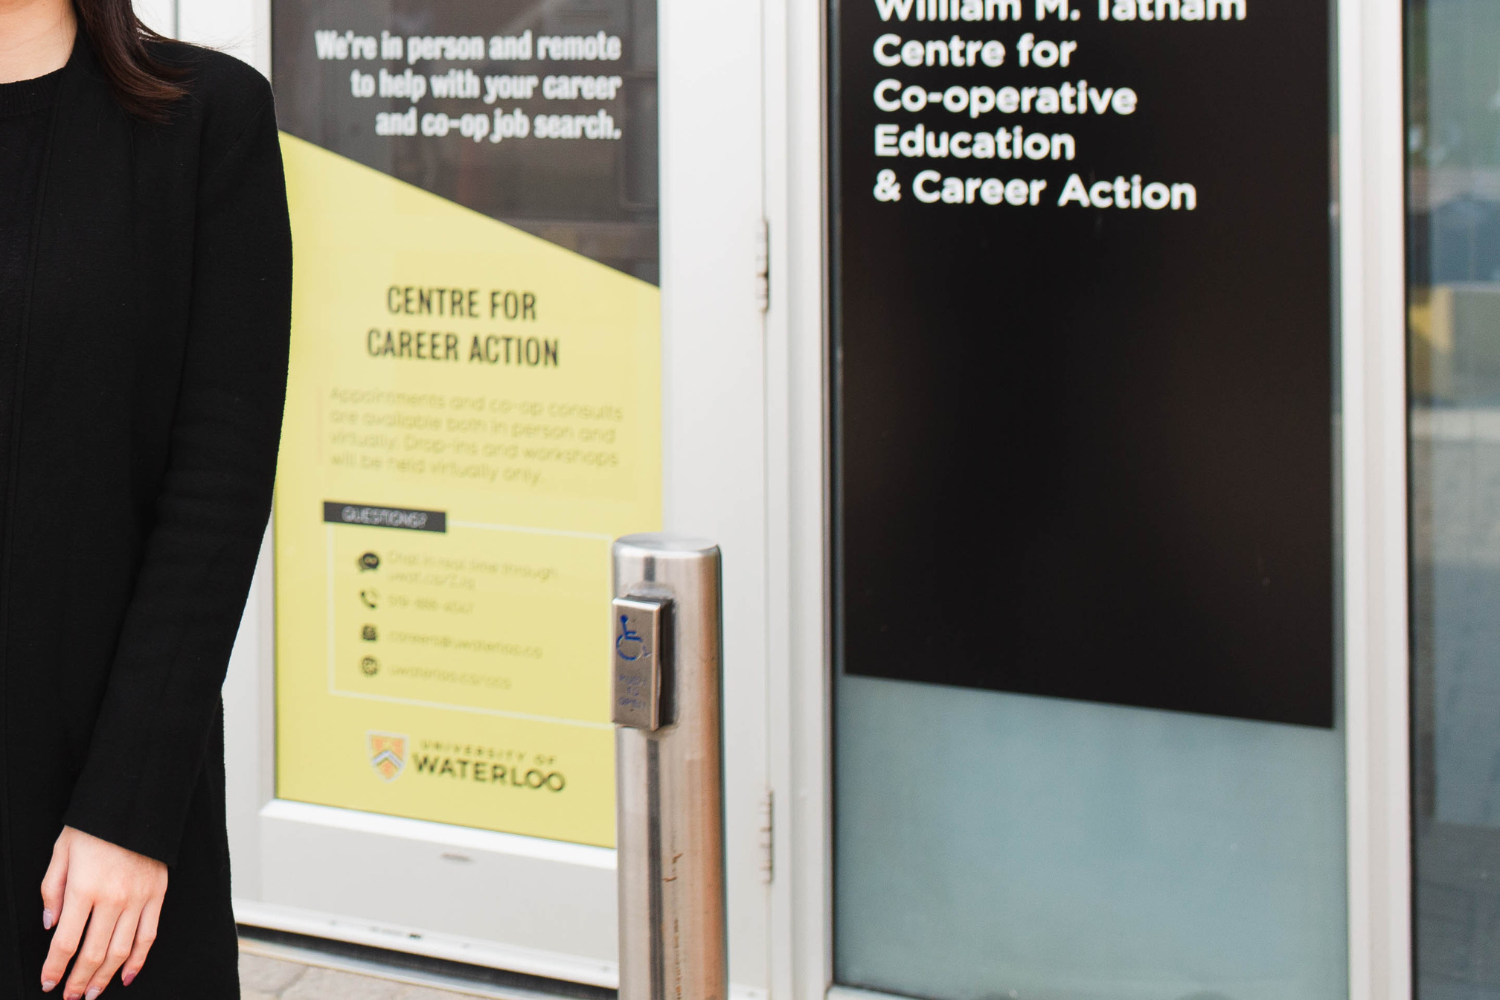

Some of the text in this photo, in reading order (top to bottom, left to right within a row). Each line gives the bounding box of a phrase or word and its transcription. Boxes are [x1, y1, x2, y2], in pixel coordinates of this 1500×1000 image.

[315, 30, 621, 65] We're in person and remote
[874, 33, 1077, 67] Centre for
[351, 68, 621, 104] to help with your career
[874, 79, 1138, 117] Co-operative
[376, 107, 621, 143] and co-op job search.
[874, 125, 1075, 160] Education
[874, 170, 1197, 210] & Career Action
[387, 285, 537, 321] CENTRE FOR
[367, 329, 559, 367] CAREER ACTION
[330, 387, 623, 422] Appointments and co-op consults
[330, 410, 616, 444] are available both in person and
[360, 453, 382, 470] be
[387, 454, 426, 474] held
[430, 458, 499, 482] virtually
[482, 440, 519, 459] and
[523, 446, 619, 468] workshops
[342, 506, 427, 528] QUESTIONS?
[421, 740, 557, 766] UNIVERSITY OF
[413, 753, 566, 793] WATERLOO
